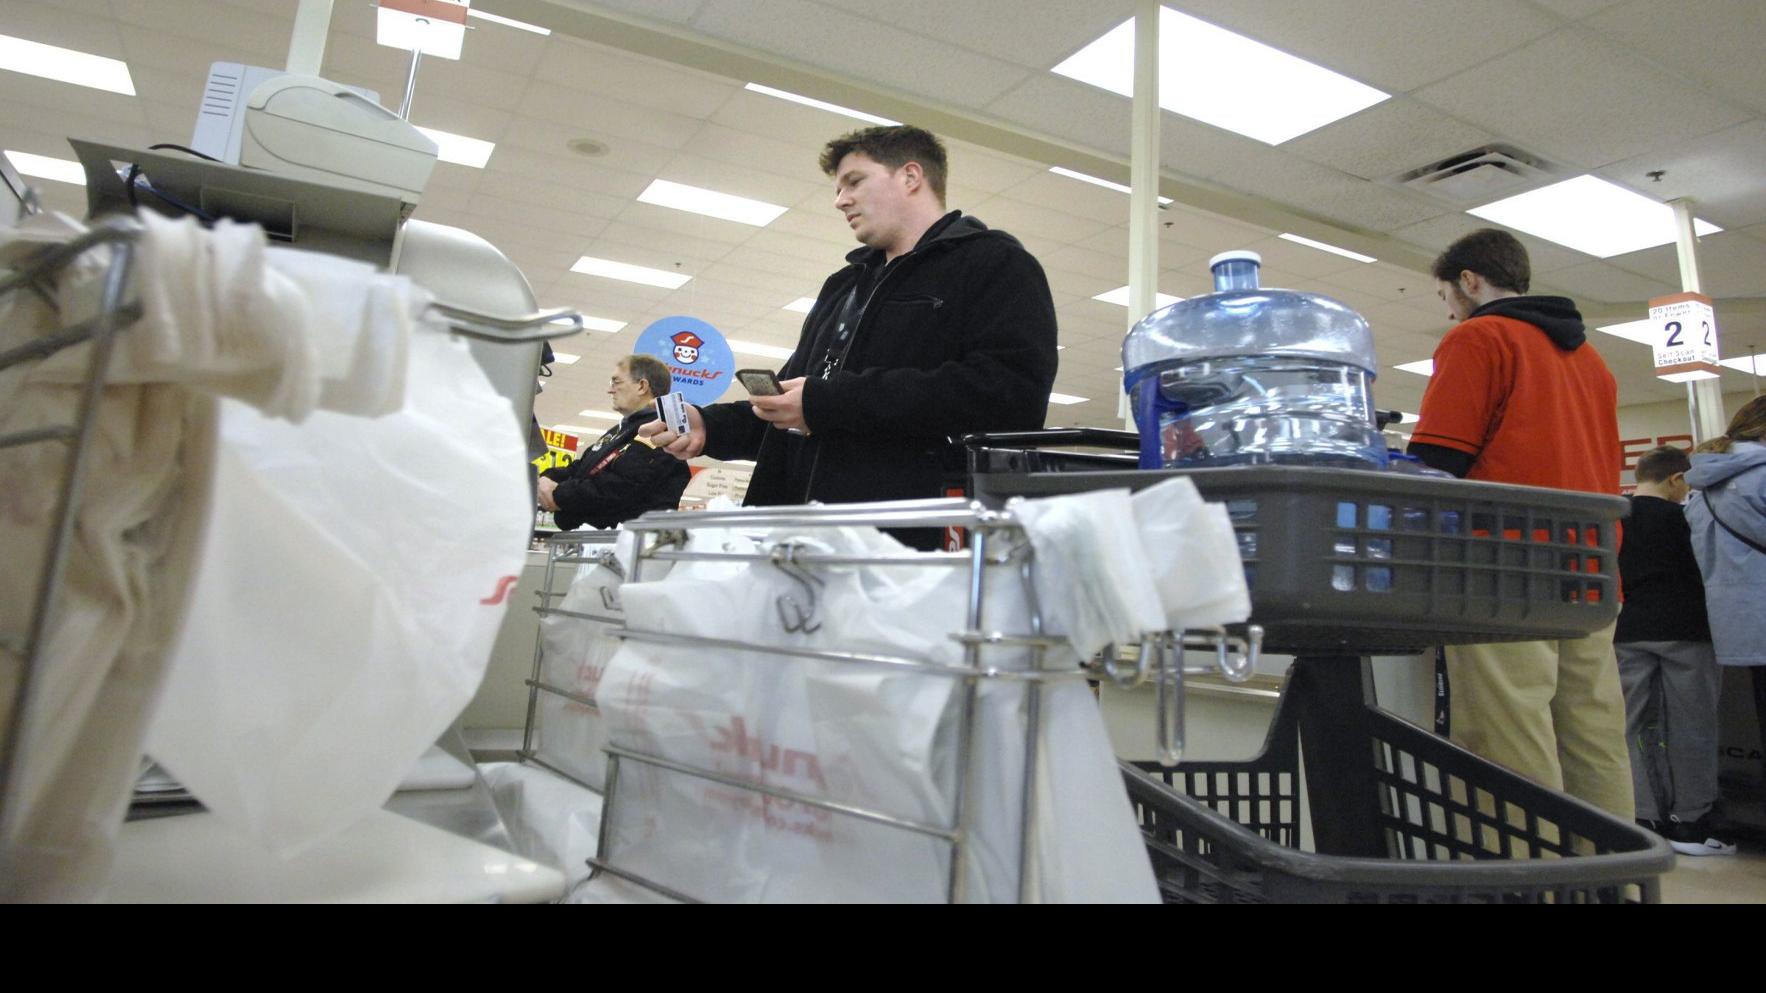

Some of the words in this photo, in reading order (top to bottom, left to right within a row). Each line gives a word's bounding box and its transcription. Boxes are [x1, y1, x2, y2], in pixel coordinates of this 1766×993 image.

[1664, 321, 1684, 347] 2
[1702, 320, 1711, 347] 2
[1658, 355, 1696, 365] Checkout
[669, 366, 724, 380] nucks
[672, 376, 705, 386] WARDS
[541, 428, 567, 449] LE!
